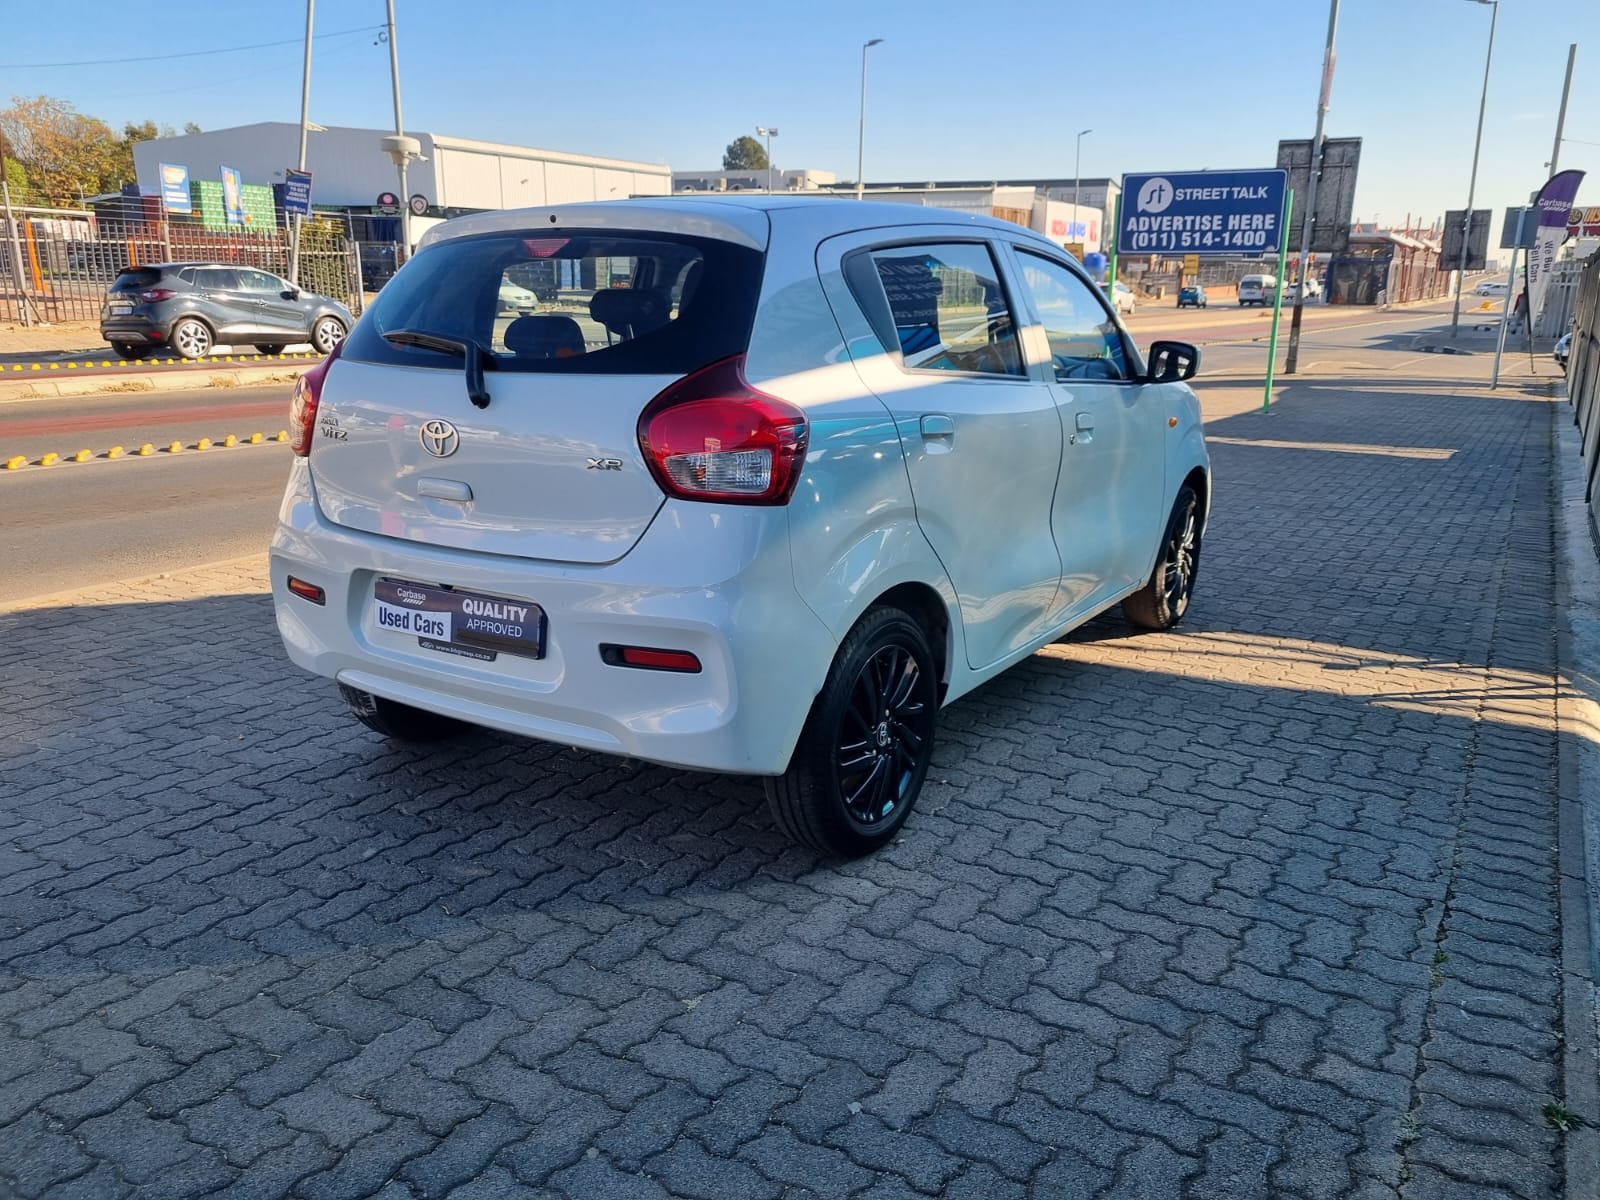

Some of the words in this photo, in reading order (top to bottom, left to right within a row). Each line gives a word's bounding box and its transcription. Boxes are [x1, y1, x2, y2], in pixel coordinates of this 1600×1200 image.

[1175, 188, 1229, 201] STREET
[1231, 186, 1269, 199] TALK
[1126, 215, 1223, 232] ADVERTISE
[1228, 214, 1276, 230] HERE
[1132, 231, 1176, 250] (011)
[1181, 231, 1266, 247] 514-1400
[1544, 240, 1554, 255] We
[1531, 244, 1541, 262] Sell
[1529, 263, 1539, 283] Cars
[1542, 256, 1553, 274] Buy
[585, 457, 623, 471] XR
[397, 587, 426, 601] Carbase
[462, 598, 529, 623] QUALITY
[379, 606, 410, 630] Used
[413, 613, 444, 637] Cars
[466, 618, 523, 638] APPROVED
